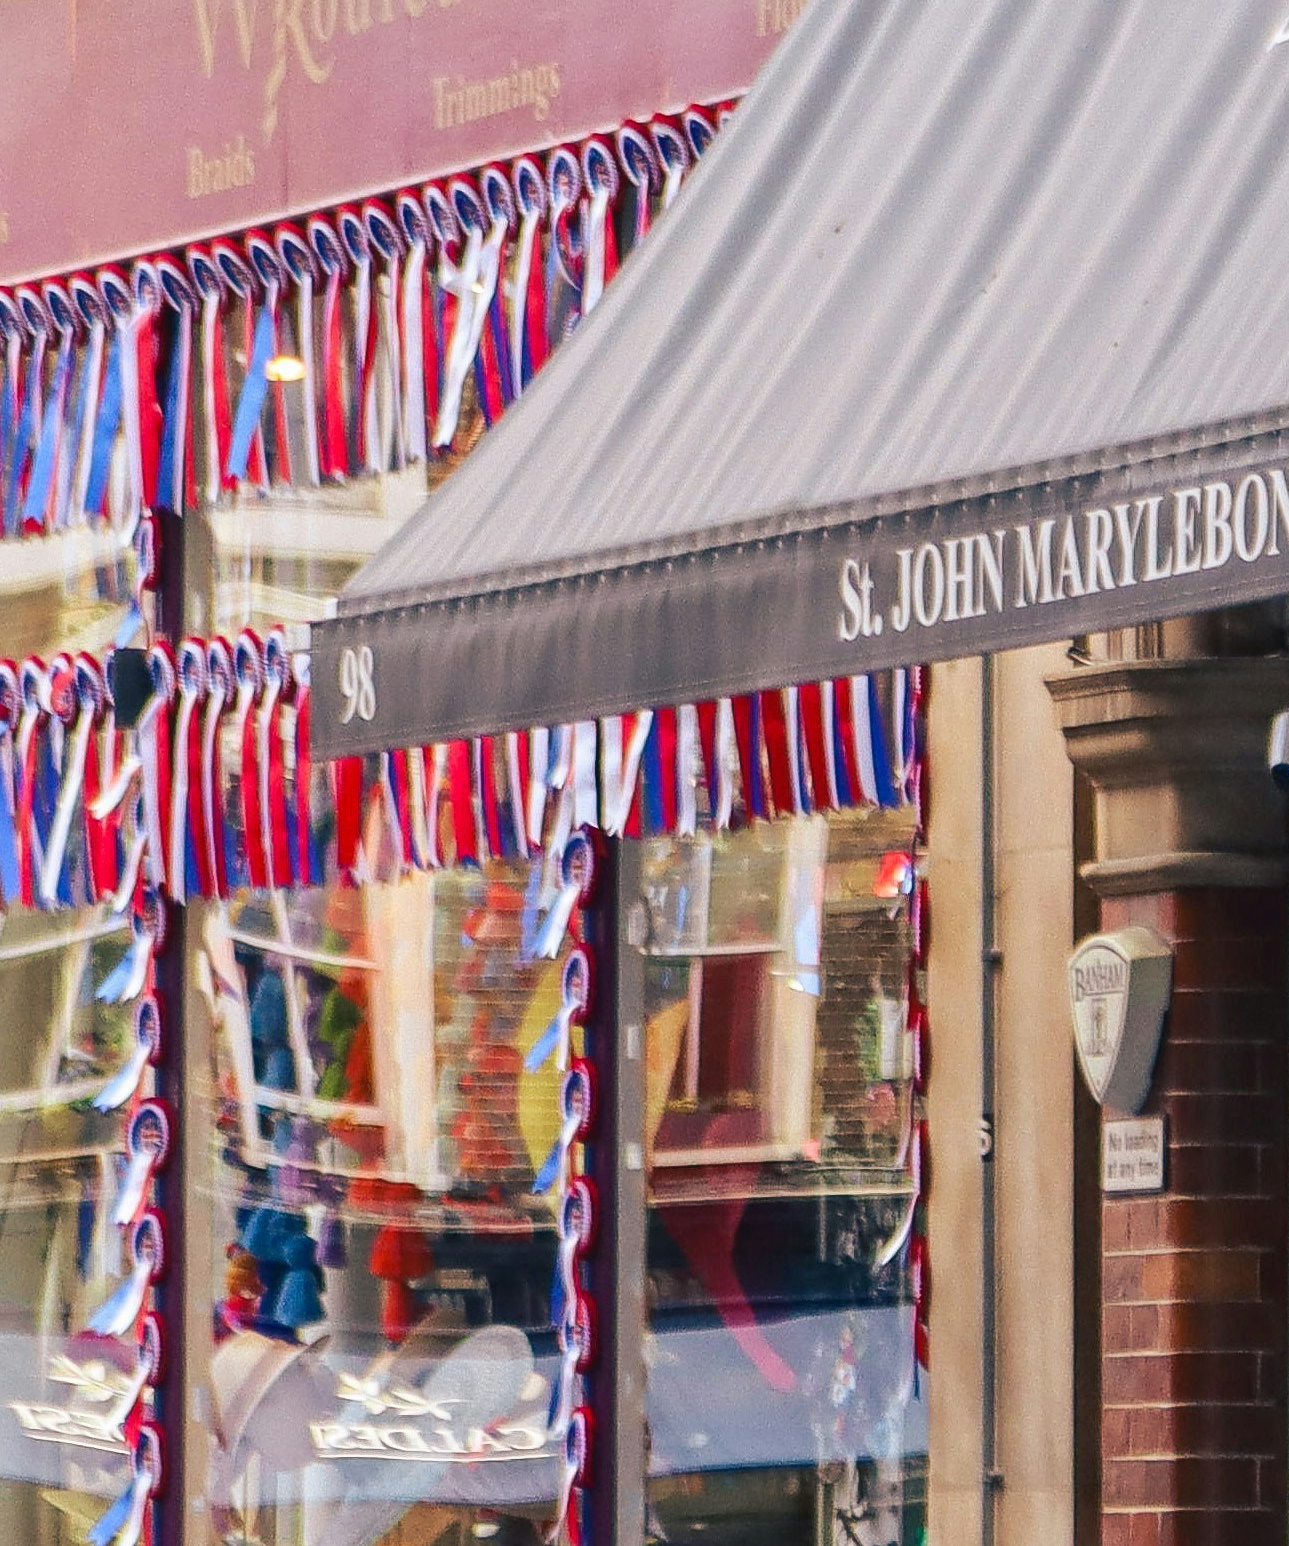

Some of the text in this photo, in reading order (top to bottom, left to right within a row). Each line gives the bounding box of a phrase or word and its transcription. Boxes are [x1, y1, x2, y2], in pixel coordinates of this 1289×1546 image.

[430, 59, 561, 129] Trimmings
[838, 557, 883, 642] St.
[891, 529, 1006, 633] JOHN
[341, 645, 376, 724] 98
